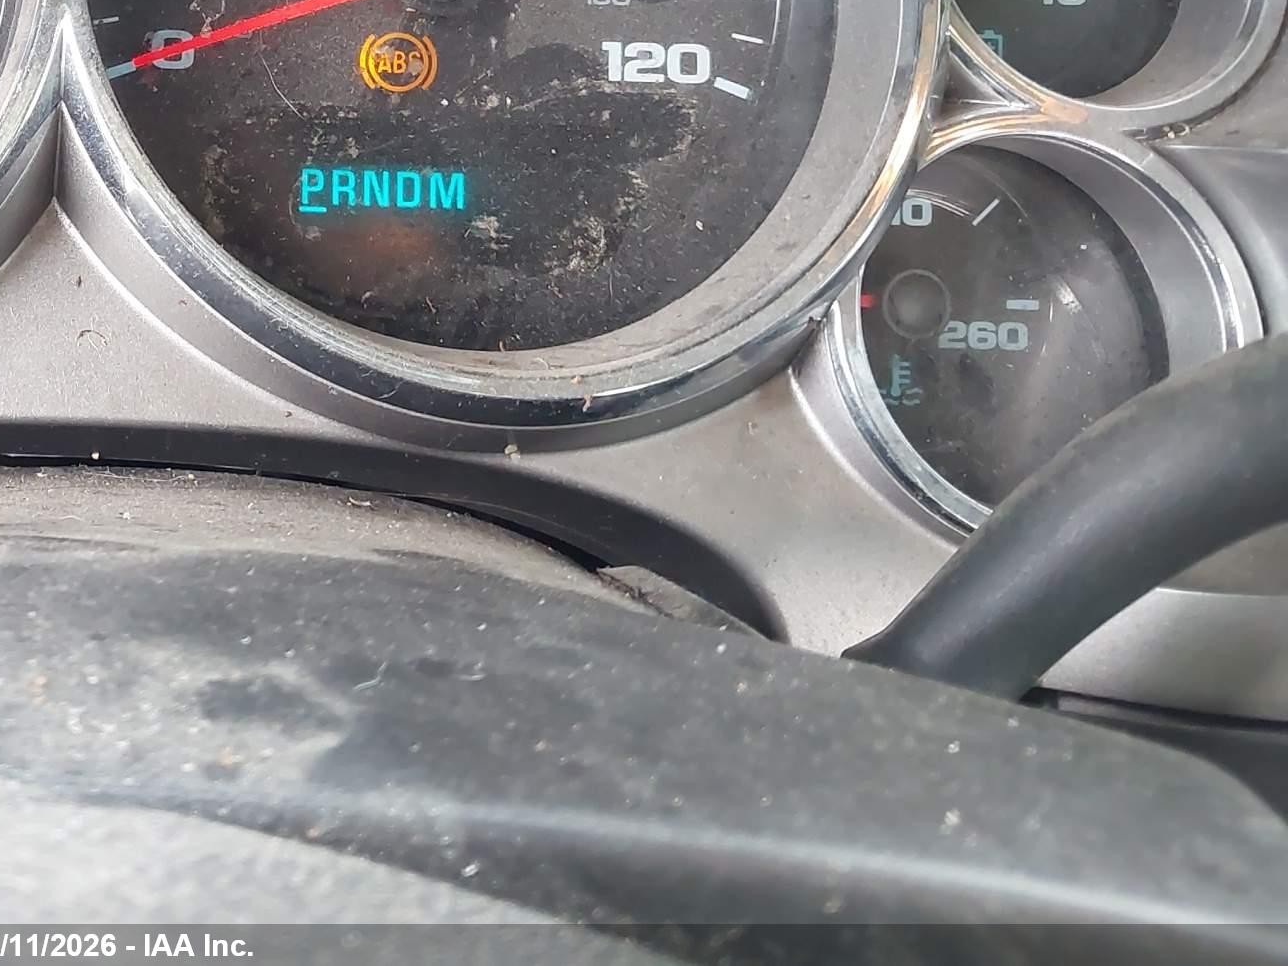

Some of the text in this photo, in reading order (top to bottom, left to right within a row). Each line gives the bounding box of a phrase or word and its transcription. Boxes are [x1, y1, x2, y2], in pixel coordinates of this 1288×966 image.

[147, 29, 194, 70] 0
[601, 41, 711, 85] 120
[938, 320, 1029, 351] 260
